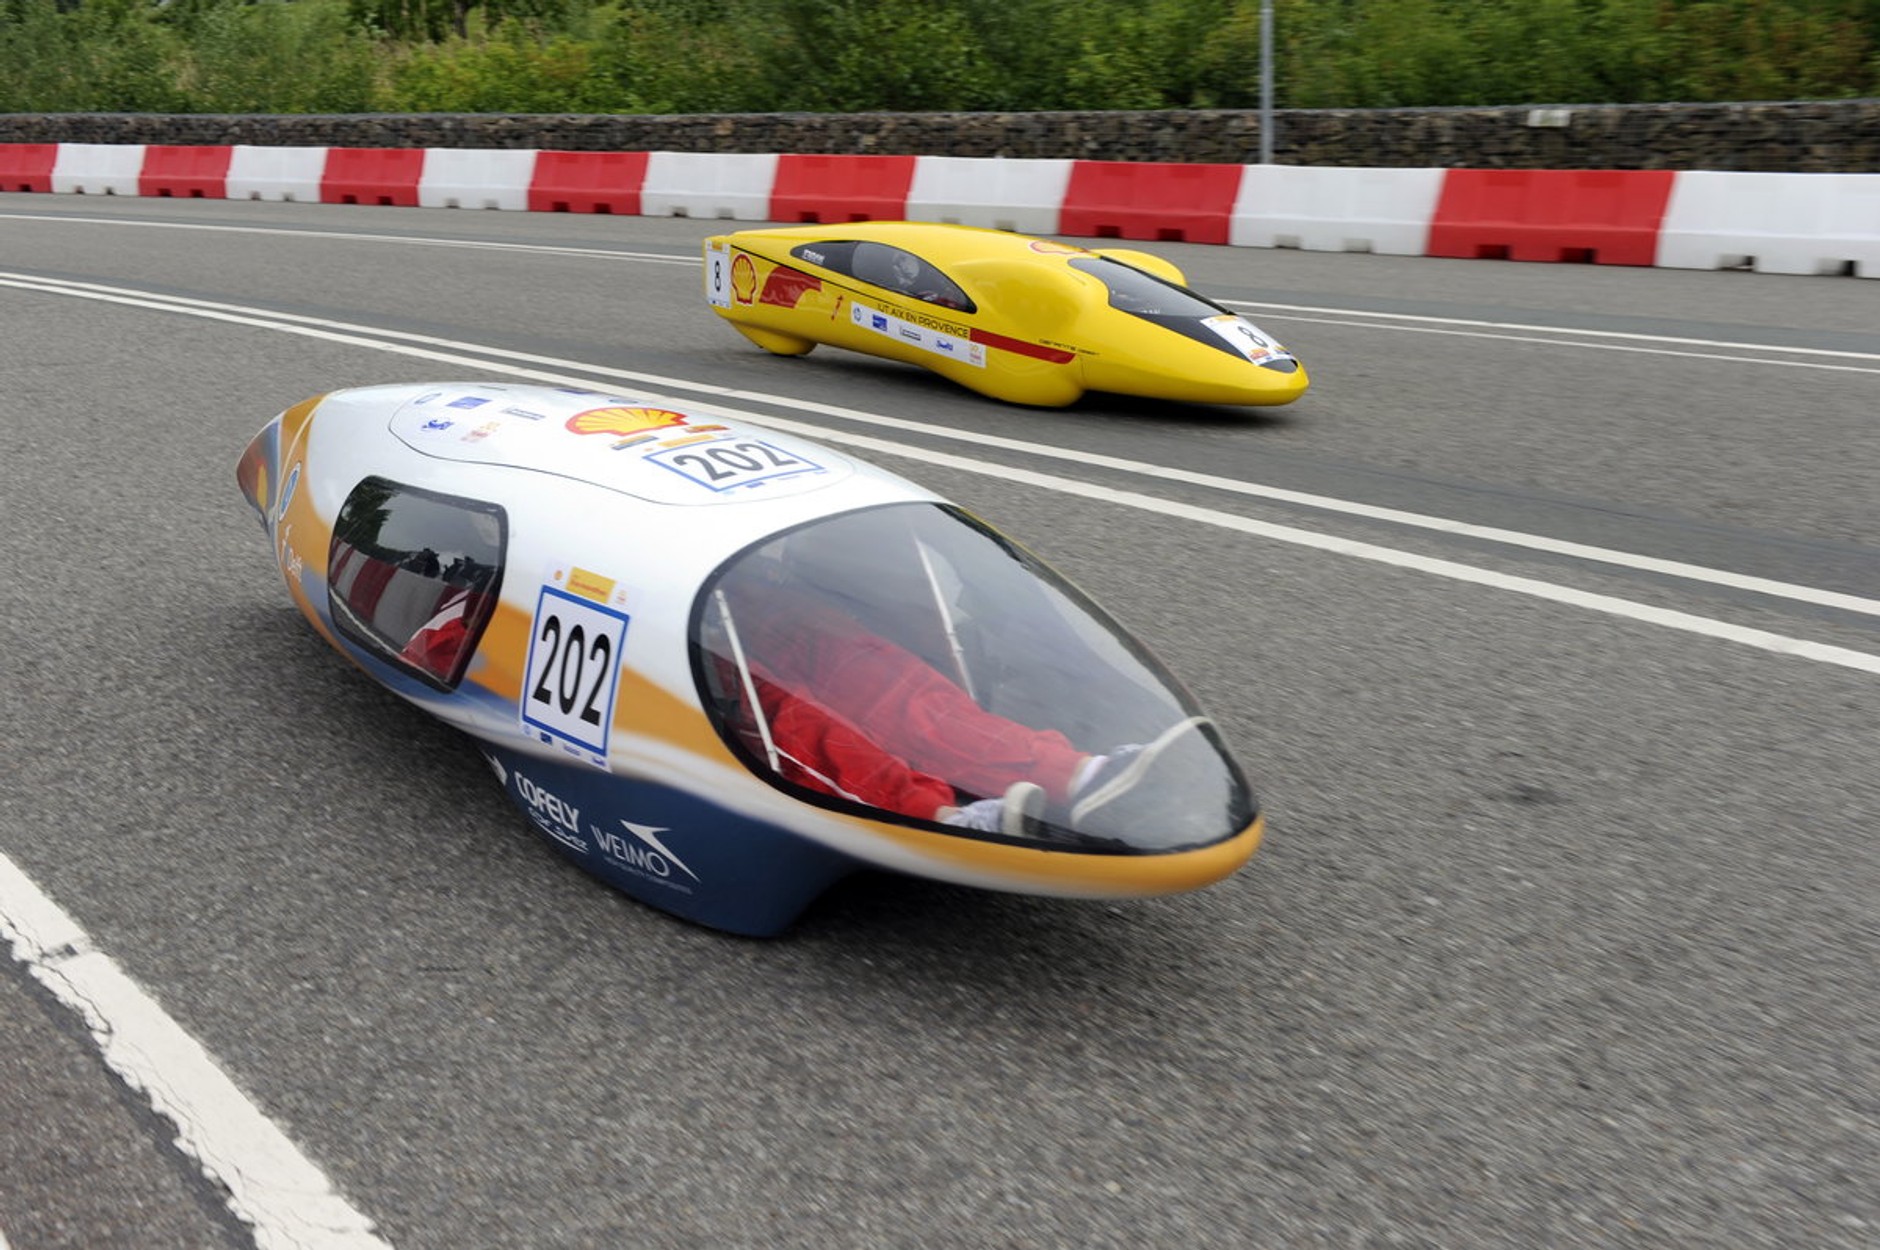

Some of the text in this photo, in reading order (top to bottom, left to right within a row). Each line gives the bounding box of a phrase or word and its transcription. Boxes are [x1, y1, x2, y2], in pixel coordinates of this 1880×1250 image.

[715, 260, 721, 292] 8
[891, 307, 905, 319] AIX
[906, 311, 917, 323] EN
[919, 316, 968, 338] PROVENCE
[1237, 326, 1269, 348] 8
[672, 443, 798, 481] 202
[532, 614, 611, 727] 202
[514, 771, 580, 834] COFELY
[590, 824, 670, 877] WEIMO
